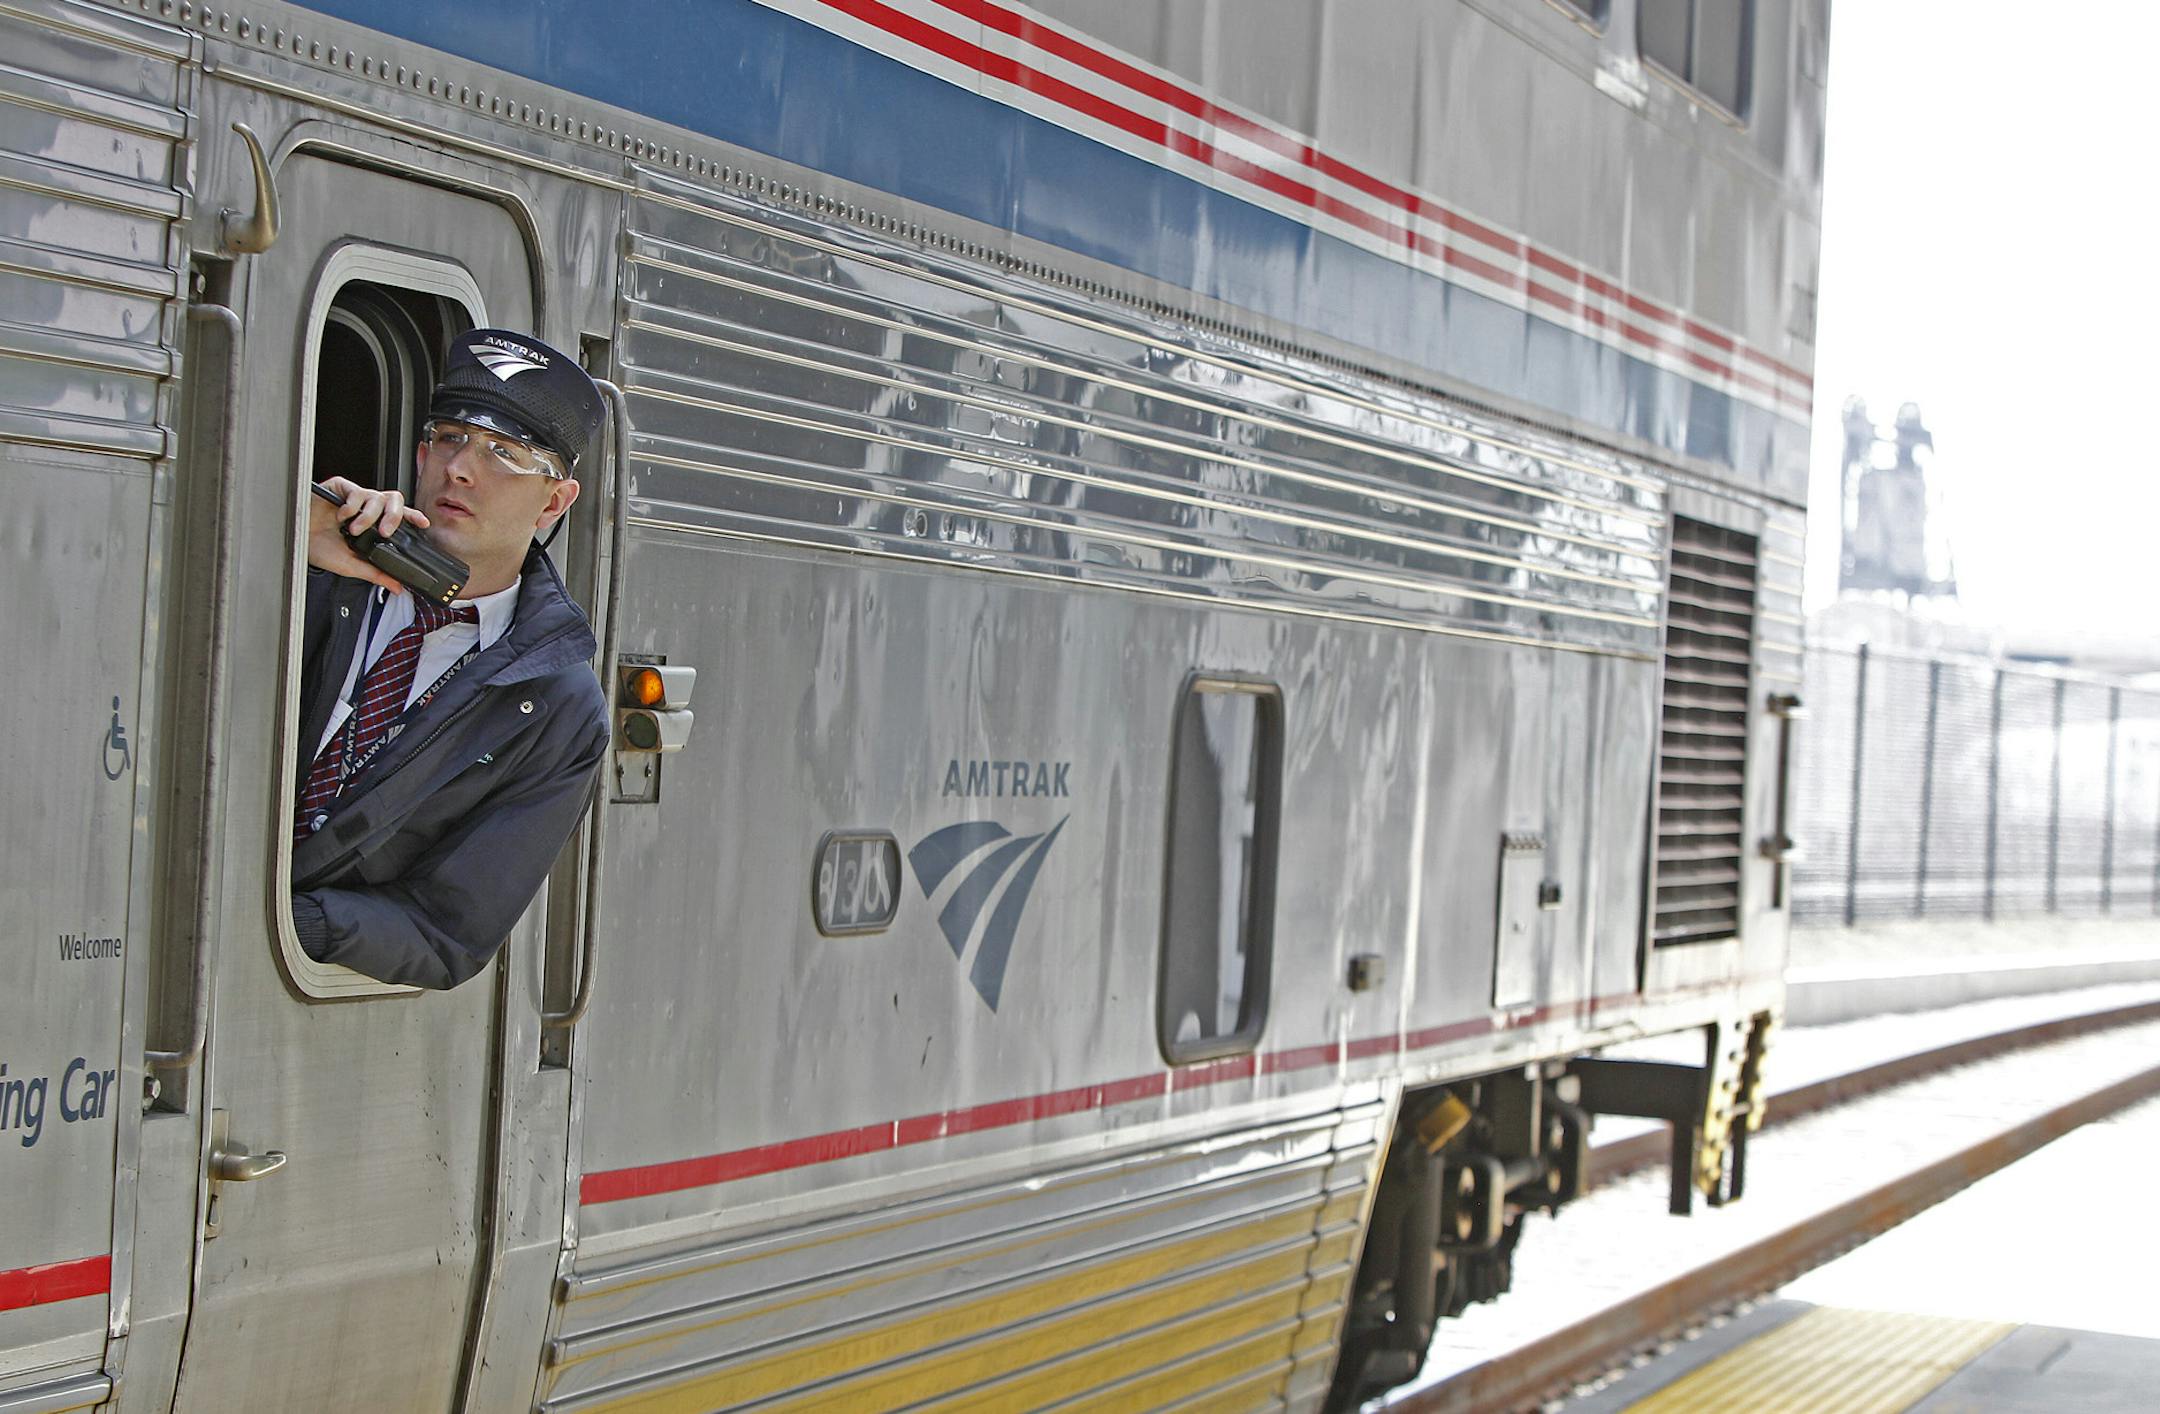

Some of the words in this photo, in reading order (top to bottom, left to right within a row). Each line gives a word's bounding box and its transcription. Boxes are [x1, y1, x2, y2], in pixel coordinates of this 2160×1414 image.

[485, 336, 549, 366] AMTRAK
[416, 661, 462, 707] AMTRAK
[942, 759, 1071, 797] AMTRAK
[59, 932, 122, 961] Welcome
[60, 1056, 116, 1123] Car
